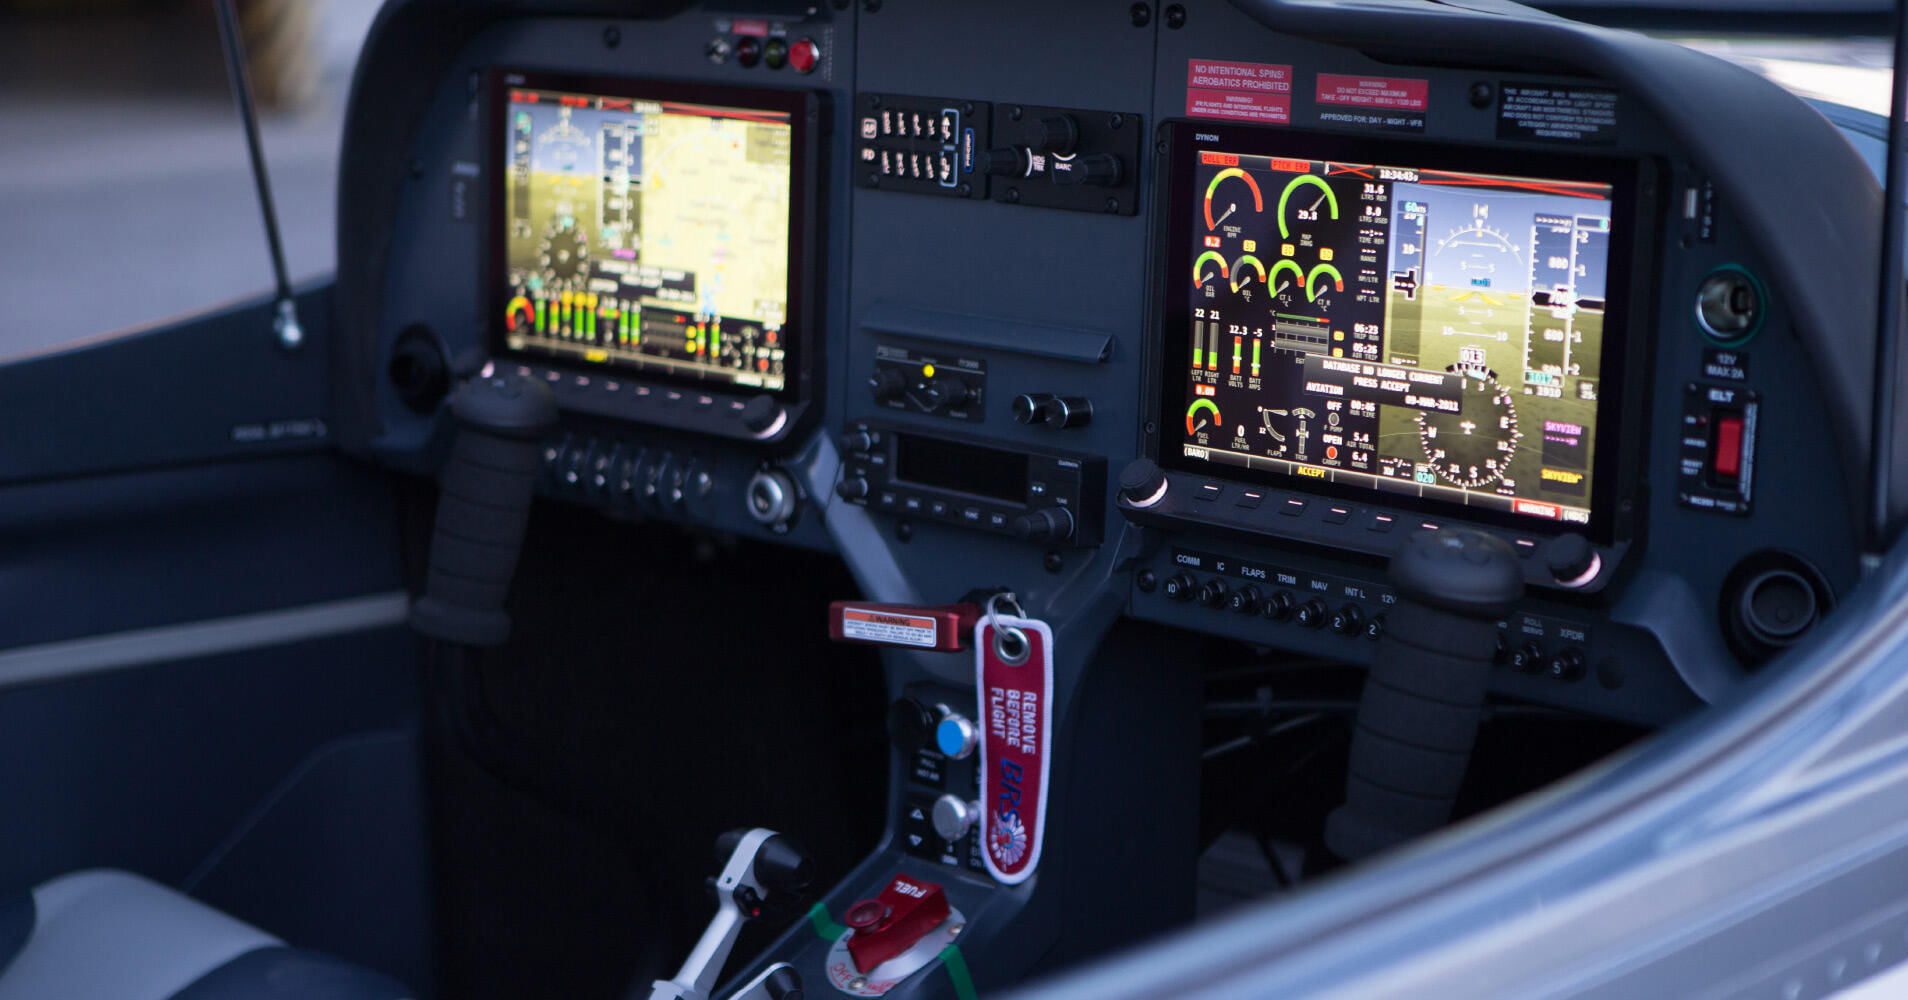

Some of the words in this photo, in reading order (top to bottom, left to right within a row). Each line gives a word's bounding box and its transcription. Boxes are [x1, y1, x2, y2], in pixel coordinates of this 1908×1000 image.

[1195, 64, 1207, 73] NO
[1208, 65, 1257, 77] INTENTIONAL
[1258, 69, 1285, 79] SPINS!
[1192, 76, 1241, 88] AEROBATICS
[1242, 80, 1289, 91] PROHIBITED
[1320, 113, 1352, 122] APPROVED
[1369, 116, 1382, 124] DAY
[1196, 133, 1219, 142] DYNON
[1203, 154, 1221, 163] ROLL
[1223, 156, 1237, 165] ERR
[1294, 162, 1309, 171] ERR
[1364, 183, 1384, 194] 31.6
[1298, 210, 1318, 221] 29.8
[1223, 225, 1242, 233] ENGINE
[1242, 289, 1252, 297] OIL
[1194, 308, 1205, 318] 22
[1210, 310, 1220, 320] 21
[1229, 324, 1248, 336] 12.3
[1253, 328, 1263, 337] -5
[1718, 354, 1737, 365] 12V
[1322, 360, 1361, 374] DATABASE
[1362, 365, 1374, 376] NO
[1376, 367, 1407, 380] LONGER
[1408, 371, 1445, 385] CURRENT
[1706, 364, 1729, 377] MAX
[1731, 368, 1744, 379] 2A
[1229, 374, 1242, 382] BATT
[1248, 377, 1261, 385] BATT
[1306, 381, 1344, 396] AVIATION
[1353, 376, 1378, 388] PRESS
[1380, 380, 1411, 393] ACCEPT
[1708, 388, 1735, 403] ELT
[1326, 400, 1342, 411] OFF
[1237, 424, 1245, 438] 0
[1545, 421, 1582, 435] SKYVIEW
[1197, 431, 1209, 439] FUEL
[1234, 436, 1246, 444] FUEL
[1322, 433, 1343, 446] OPEN
[1353, 432, 1369, 443] 5.4
[1184, 447, 1209, 461] (BARO)
[1267, 449, 1283, 458] FLAPS
[1352, 451, 1368, 462] 6.4
[1297, 466, 1326, 478] ACCEPT
[1469, 465, 1478, 478] S
[1416, 472, 1434, 484] 020
[1176, 554, 1201, 566] COMM
[1217, 562, 1225, 571] IC
[1241, 567, 1266, 579] FLAPS
[1277, 574, 1296, 585] TRIM
[1311, 580, 1328, 591] NAV
[1345, 586, 1360, 598] INT
[1168, 583, 1176, 593] 10
[1233, 597, 1240, 607] 3
[875, 615, 911, 627] WARNING
[1300, 610, 1306, 621] 4
[1334, 618, 1341, 628] 2
[1369, 624, 1376, 635] 2
[1560, 628, 1585, 641] XPDR
[1515, 654, 1522, 666] 2
[1553, 661, 1561, 674] 5
[990, 686, 1005, 740] FLIGHT
[1006, 688, 1020, 748] BEFORE
[1022, 691, 1037, 755] REMOVE
[892, 878, 927, 899] FUEL
[833, 961, 853, 983] OFF
